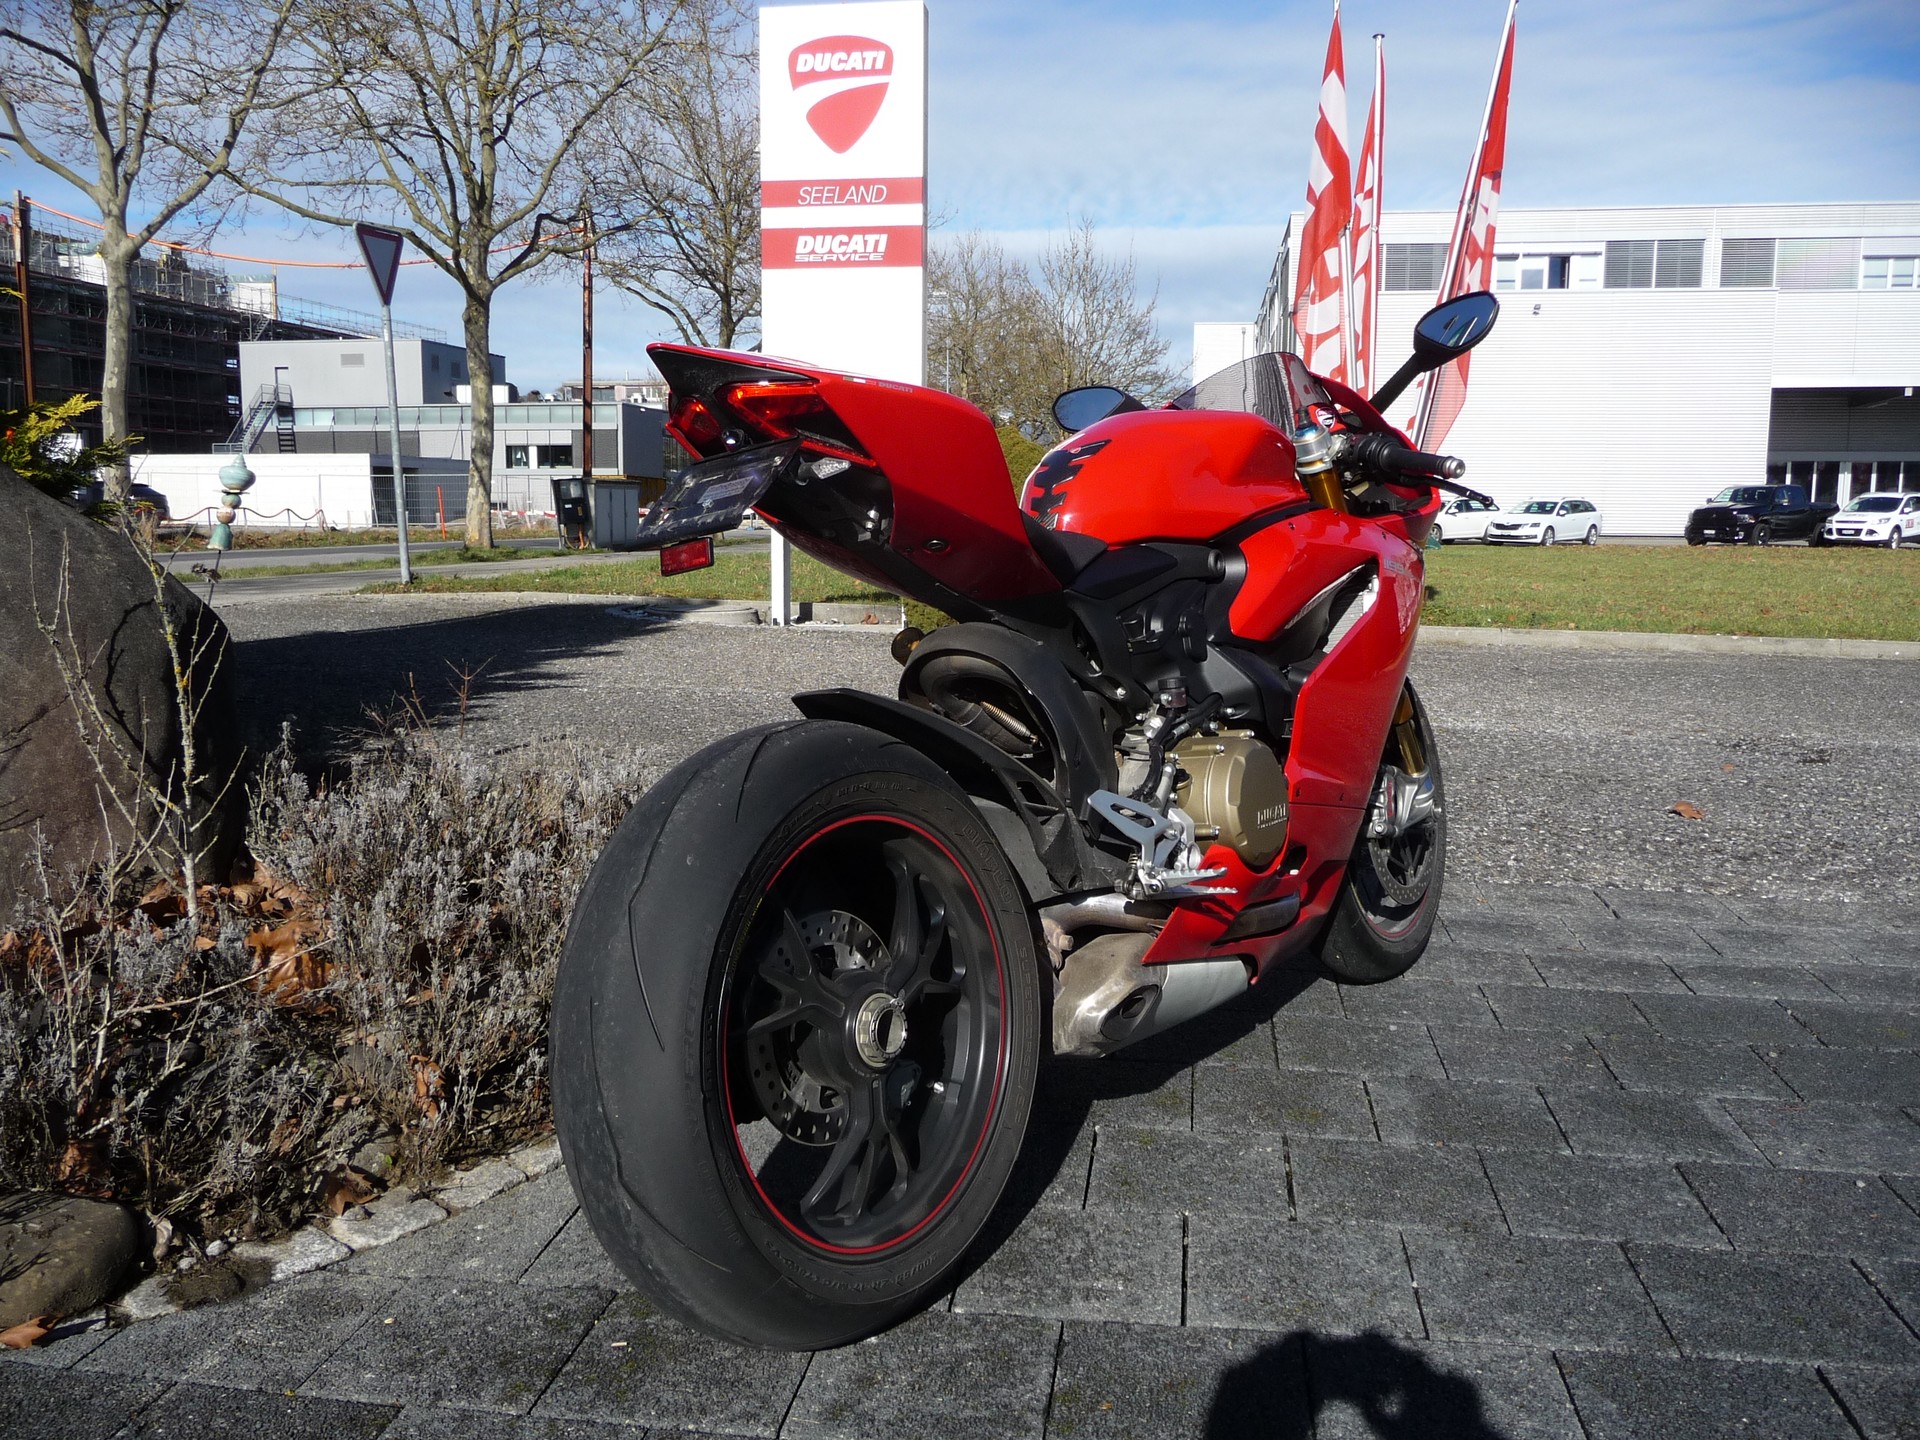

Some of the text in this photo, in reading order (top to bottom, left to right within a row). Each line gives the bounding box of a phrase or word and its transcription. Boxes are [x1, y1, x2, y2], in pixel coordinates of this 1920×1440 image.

[796, 51, 886, 72] DUCATI
[797, 184, 887, 205] SEELAND
[796, 233, 888, 254] DUCATI
[795, 253, 884, 262] SERVICE
[878, 382, 913, 393] DUCATI
